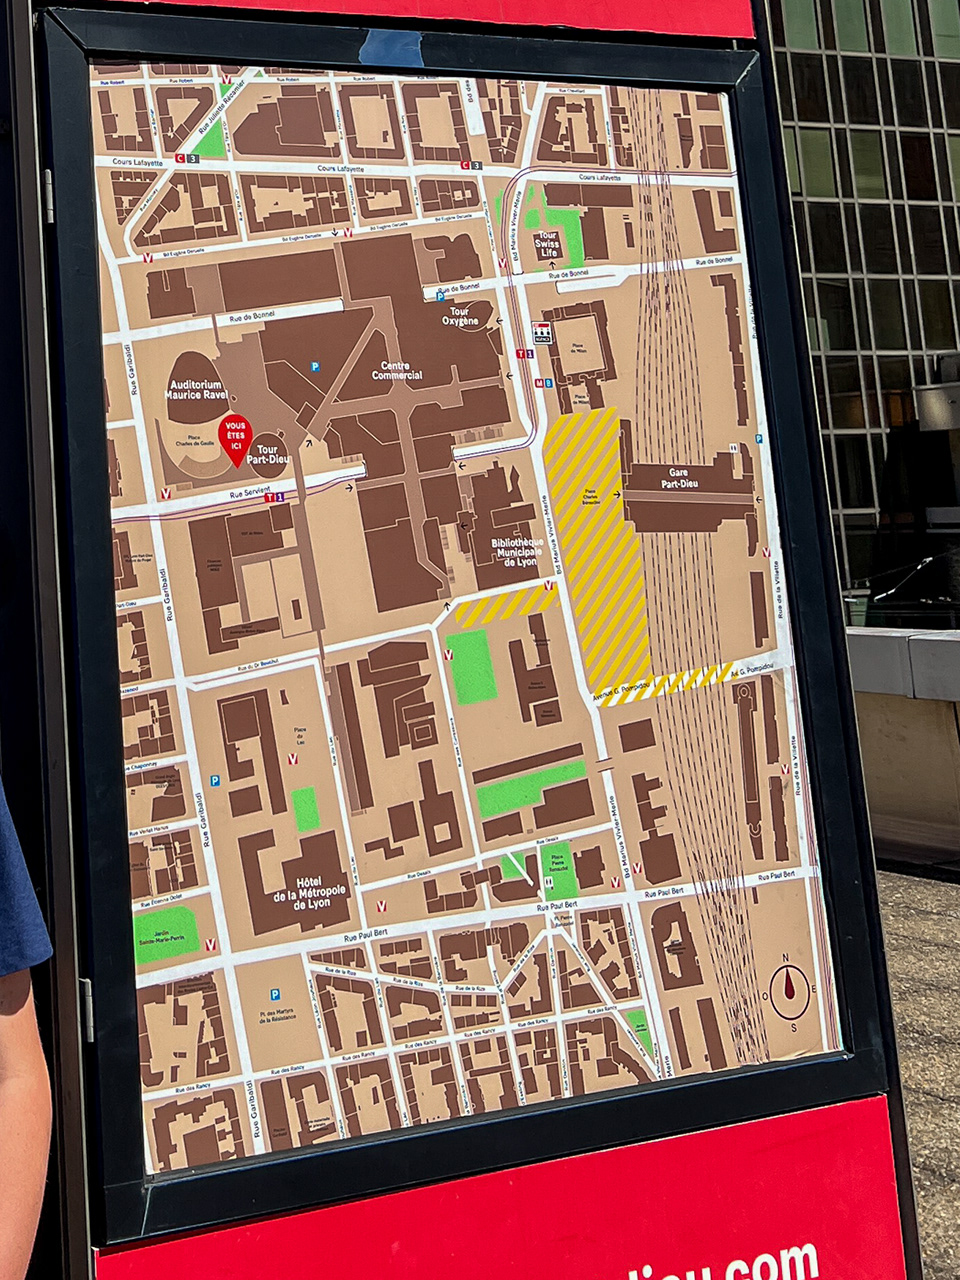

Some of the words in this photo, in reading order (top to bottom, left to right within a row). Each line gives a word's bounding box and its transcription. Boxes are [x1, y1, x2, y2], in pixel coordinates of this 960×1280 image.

[198, 122, 210, 135] Rue
[208, 102, 225, 124] Juliette
[134, 158, 163, 167] Lafayette
[539, 231, 557, 240] Tour
[534, 240, 559, 249] Swiss
[541, 248, 558, 258] Life
[450, 307, 469, 316] Tour
[229, 314, 243, 324] Rue
[441, 315, 479, 327] Oxygène
[124, 344, 135, 378] Garibaldi
[380, 360, 410, 371] Centre
[371, 370, 423, 381] Commercial
[170, 380, 222, 390] Auditorium
[164, 390, 201, 399] Maurice
[203, 390, 229, 399] Ravel
[225, 422, 246, 430] VOUS
[227, 430, 245, 440] ÊTES
[256, 445, 278, 454] Tour
[246, 455, 290, 464] Part-Dieu
[668, 468, 688, 478] Gare
[661, 479, 699, 489] Part-Dieu
[229, 491, 243, 499] Rue
[244, 486, 271, 496] Servient
[491, 538, 544, 548] Bibliothèque
[497, 548, 542, 558] Municipale
[504, 558, 515, 567] de
[517, 558, 537, 568] Lyon
[159, 568, 171, 603] Garibaldi
[592, 690, 613, 701] Avenue
[195, 792, 207, 829] Garibaldi
[296, 876, 322, 888] Hôtel
[273, 893, 286, 902] de
[287, 890, 297, 900] la
[298, 884, 346, 899] Métropole
[644, 891, 657, 899] Rue
[658, 889, 670, 897] Paul
[671, 887, 684, 895] Bert
[293, 901, 306, 911] de
[308, 897, 331, 909] Lyon
[550, 902, 563, 910] Paul
[565, 901, 578, 909] Bert
[344, 934, 357, 943] Rue
[359, 931, 373, 939] Paul
[374, 928, 388, 937] Bert
[782, 953, 789, 962] N
[791, 1024, 797, 1033] S
[245, 1080, 258, 1119] Garibaldi
